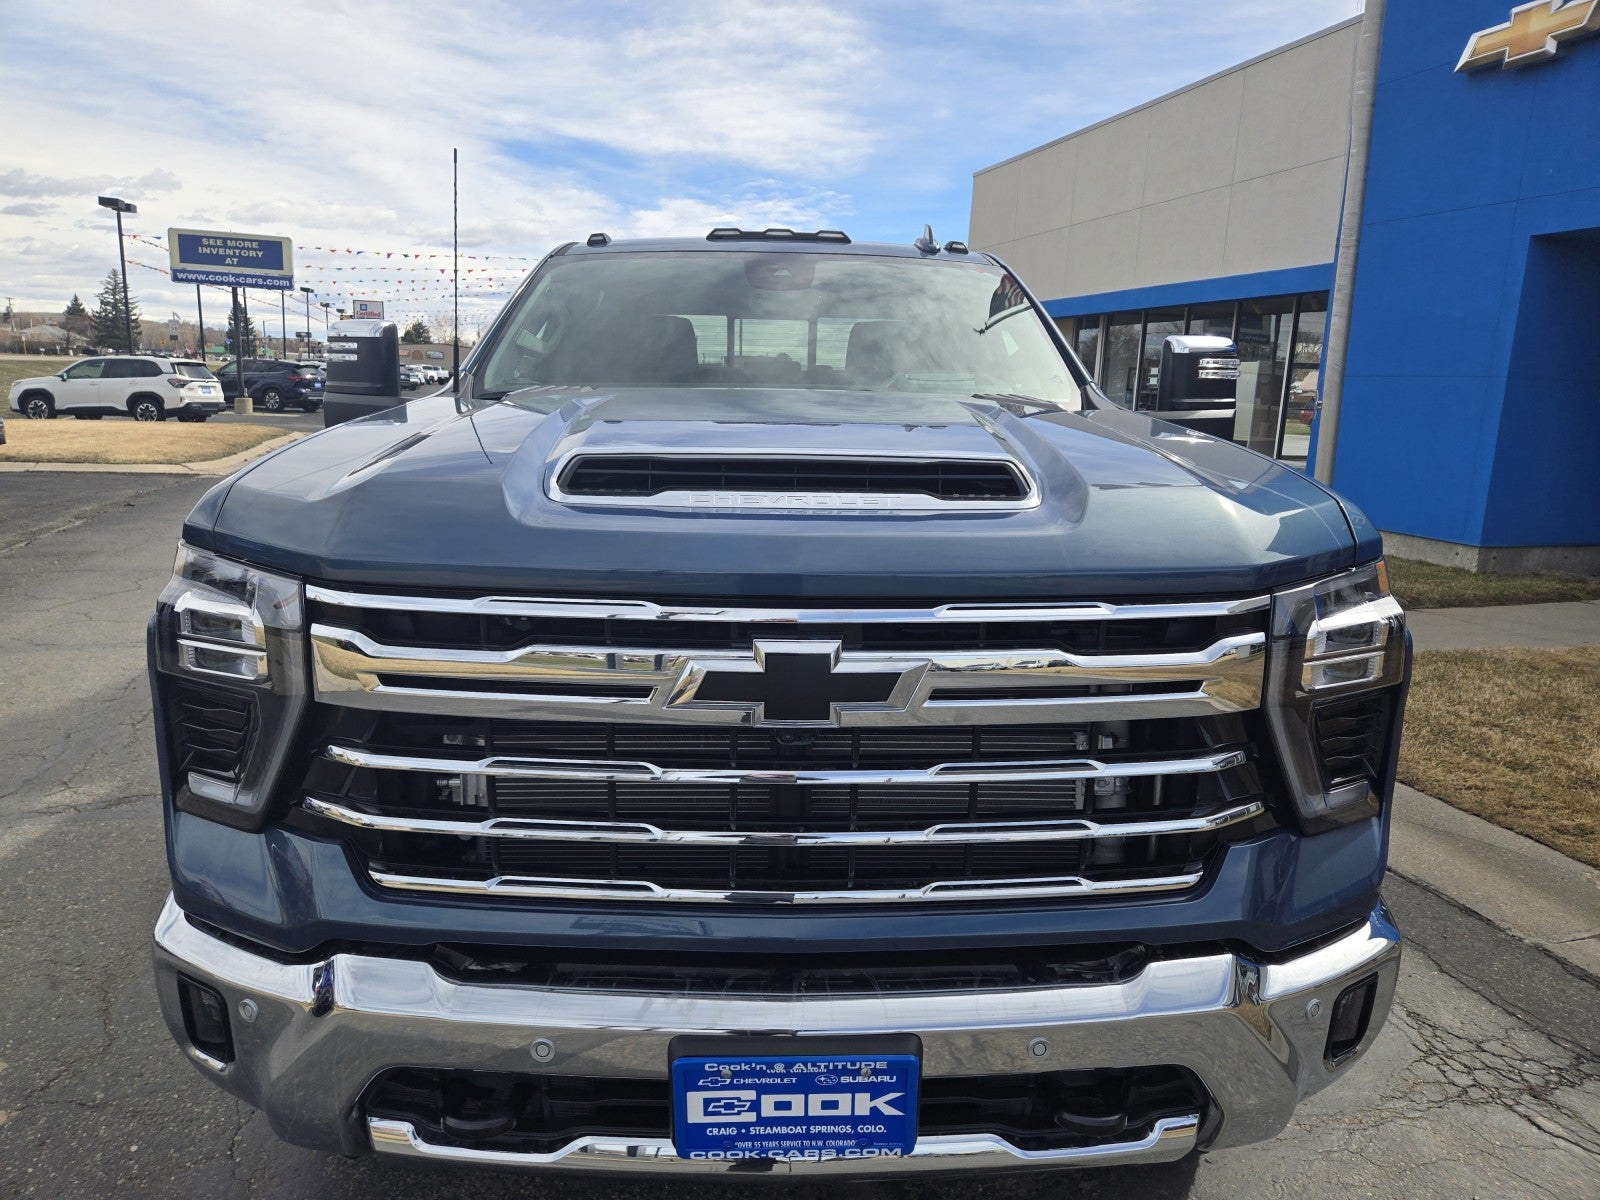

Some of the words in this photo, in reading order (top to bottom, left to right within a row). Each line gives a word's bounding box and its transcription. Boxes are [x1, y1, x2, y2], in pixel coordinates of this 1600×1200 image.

[202, 238, 223, 246] SEE
[227, 240, 259, 248] MORE
[198, 246, 264, 258] INVENTORY
[177, 272, 290, 286] www.cook-cars.com
[690, 494, 901, 504] CHEVROLET
[792, 1062, 888, 1070] ALTITUDE
[706, 1127, 738, 1136] CRAIG
[750, 1126, 807, 1135] STEAMBOAT
[810, 1125, 854, 1134] SPRINGS,
[857, 1124, 887, 1132] COLO.
[690, 1148, 902, 1159] COOK-CARS.COM
